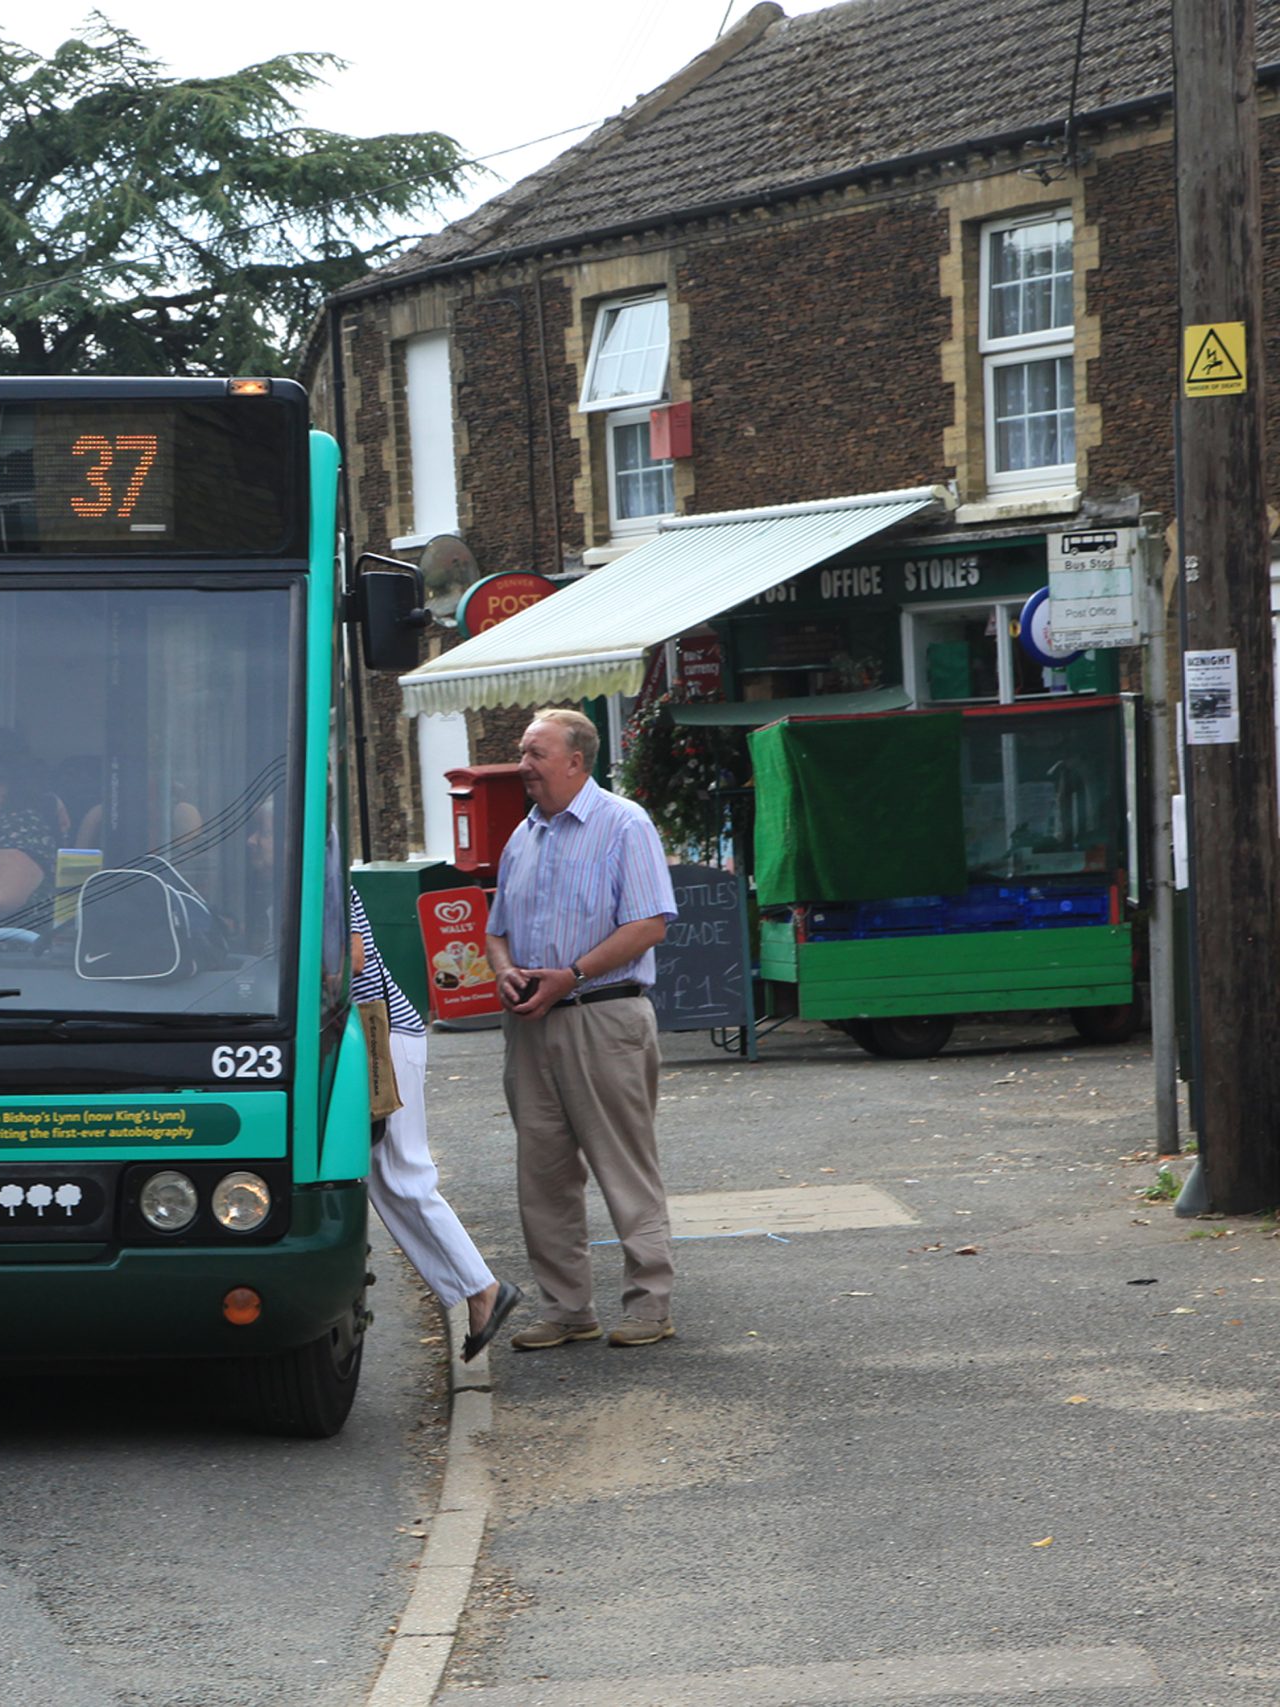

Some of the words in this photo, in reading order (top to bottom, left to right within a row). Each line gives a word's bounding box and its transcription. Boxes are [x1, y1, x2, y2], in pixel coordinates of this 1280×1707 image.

[71, 435, 157, 517] 37
[1065, 560, 1086, 569] Bus
[1090, 558, 1115, 568] Stop
[495, 579, 534, 590] DENVER
[754, 581, 797, 605] OST
[821, 565, 882, 599] OFFICE
[904, 556, 980, 592] STORES
[1065, 608, 1087, 618] Post
[1089, 606, 1117, 617] Office
[674, 881, 738, 910] OTTLES
[439, 923, 474, 934] WALL'S
[212, 1045, 282, 1078] 623
[3, 1112, 50, 1124] Bishop's
[53, 1112, 80, 1124] Lynn
[83, 1110, 113, 1124] (now
[116, 1110, 150, 1124] King's
[153, 1109, 186, 1123] Lynn)
[30, 1128, 49, 1138] the
[52, 1127, 106, 1137] first-ever
[109, 1126, 194, 1139] autobiography
